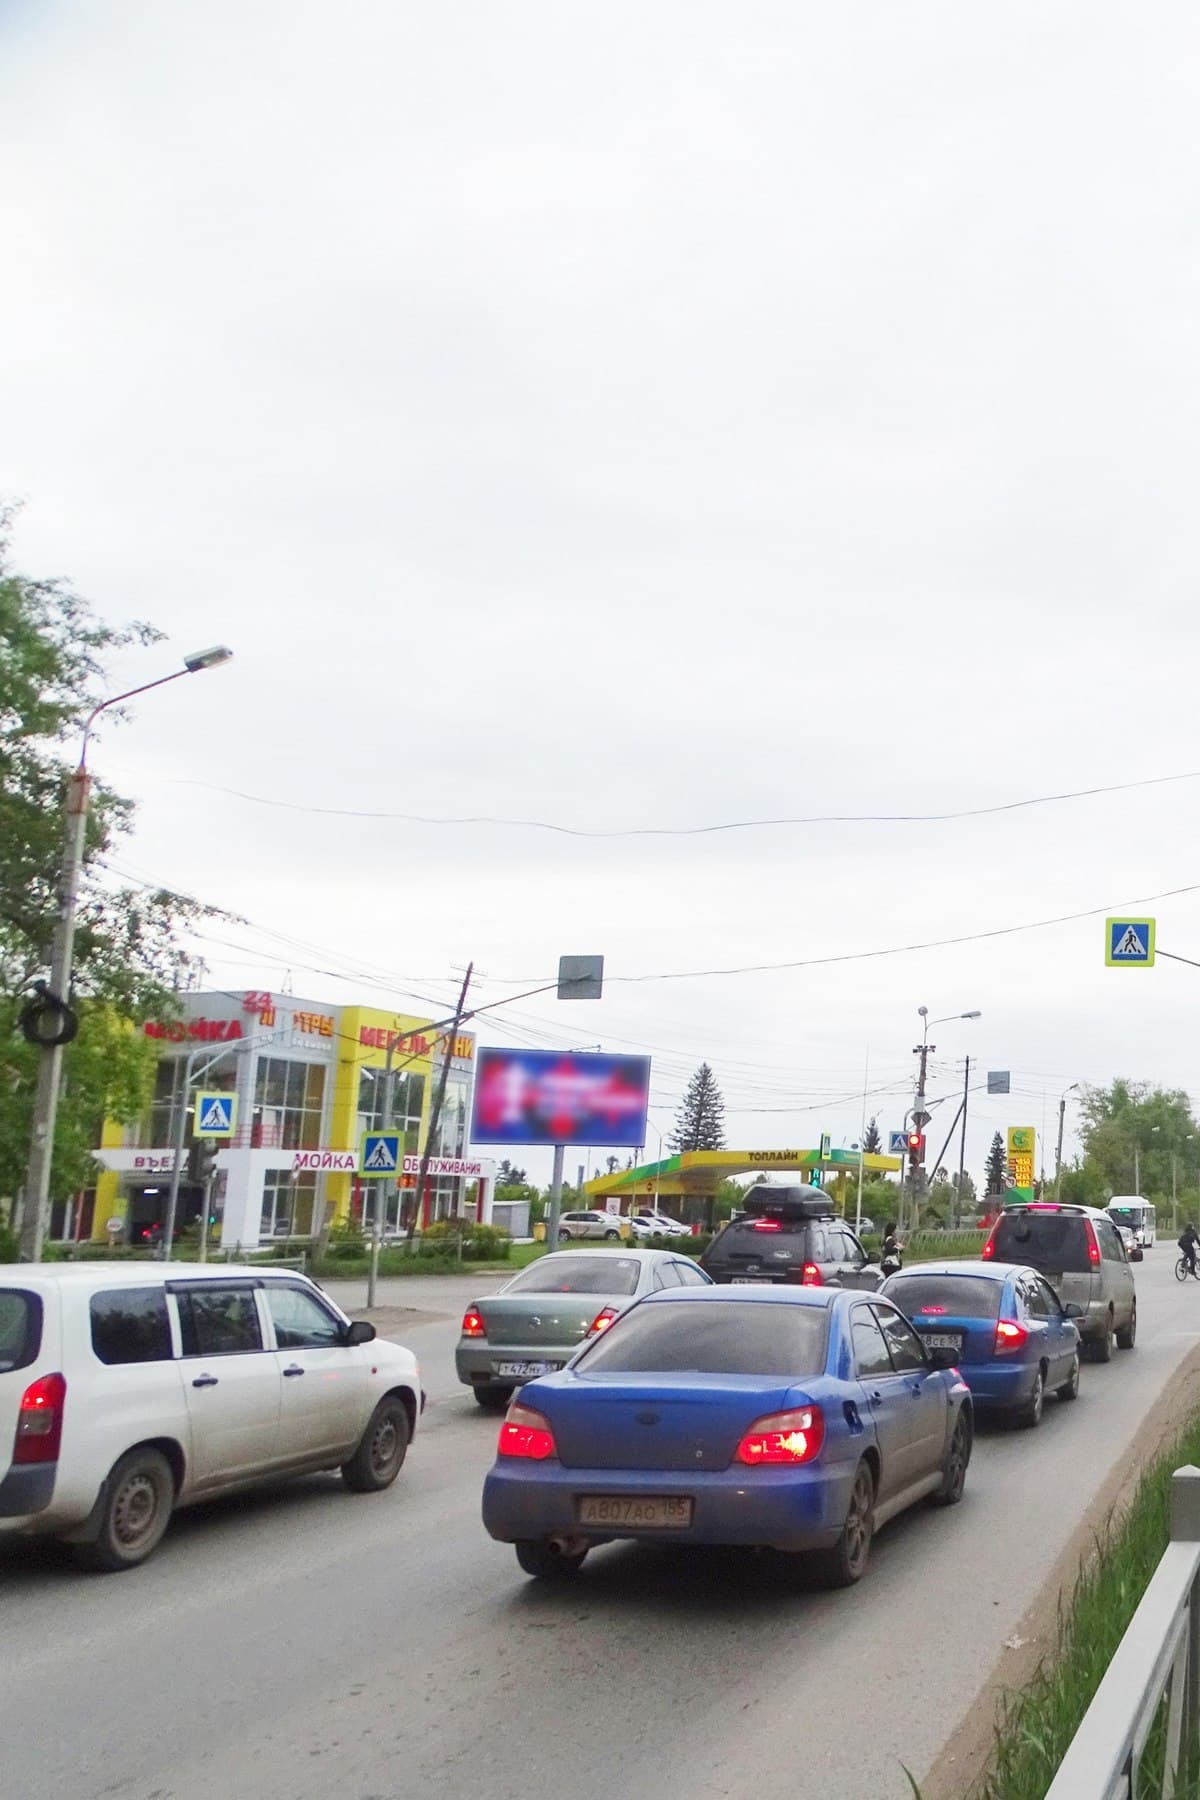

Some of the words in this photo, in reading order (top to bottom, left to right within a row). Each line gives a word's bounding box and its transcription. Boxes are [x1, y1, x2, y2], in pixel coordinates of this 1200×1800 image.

[294, 1153, 355, 1170] МОЙКА
[402, 1158, 482, 1177] ОБЛУЖИВАНИЯ
[748, 1150, 799, 1162] ТОПЛАЙН
